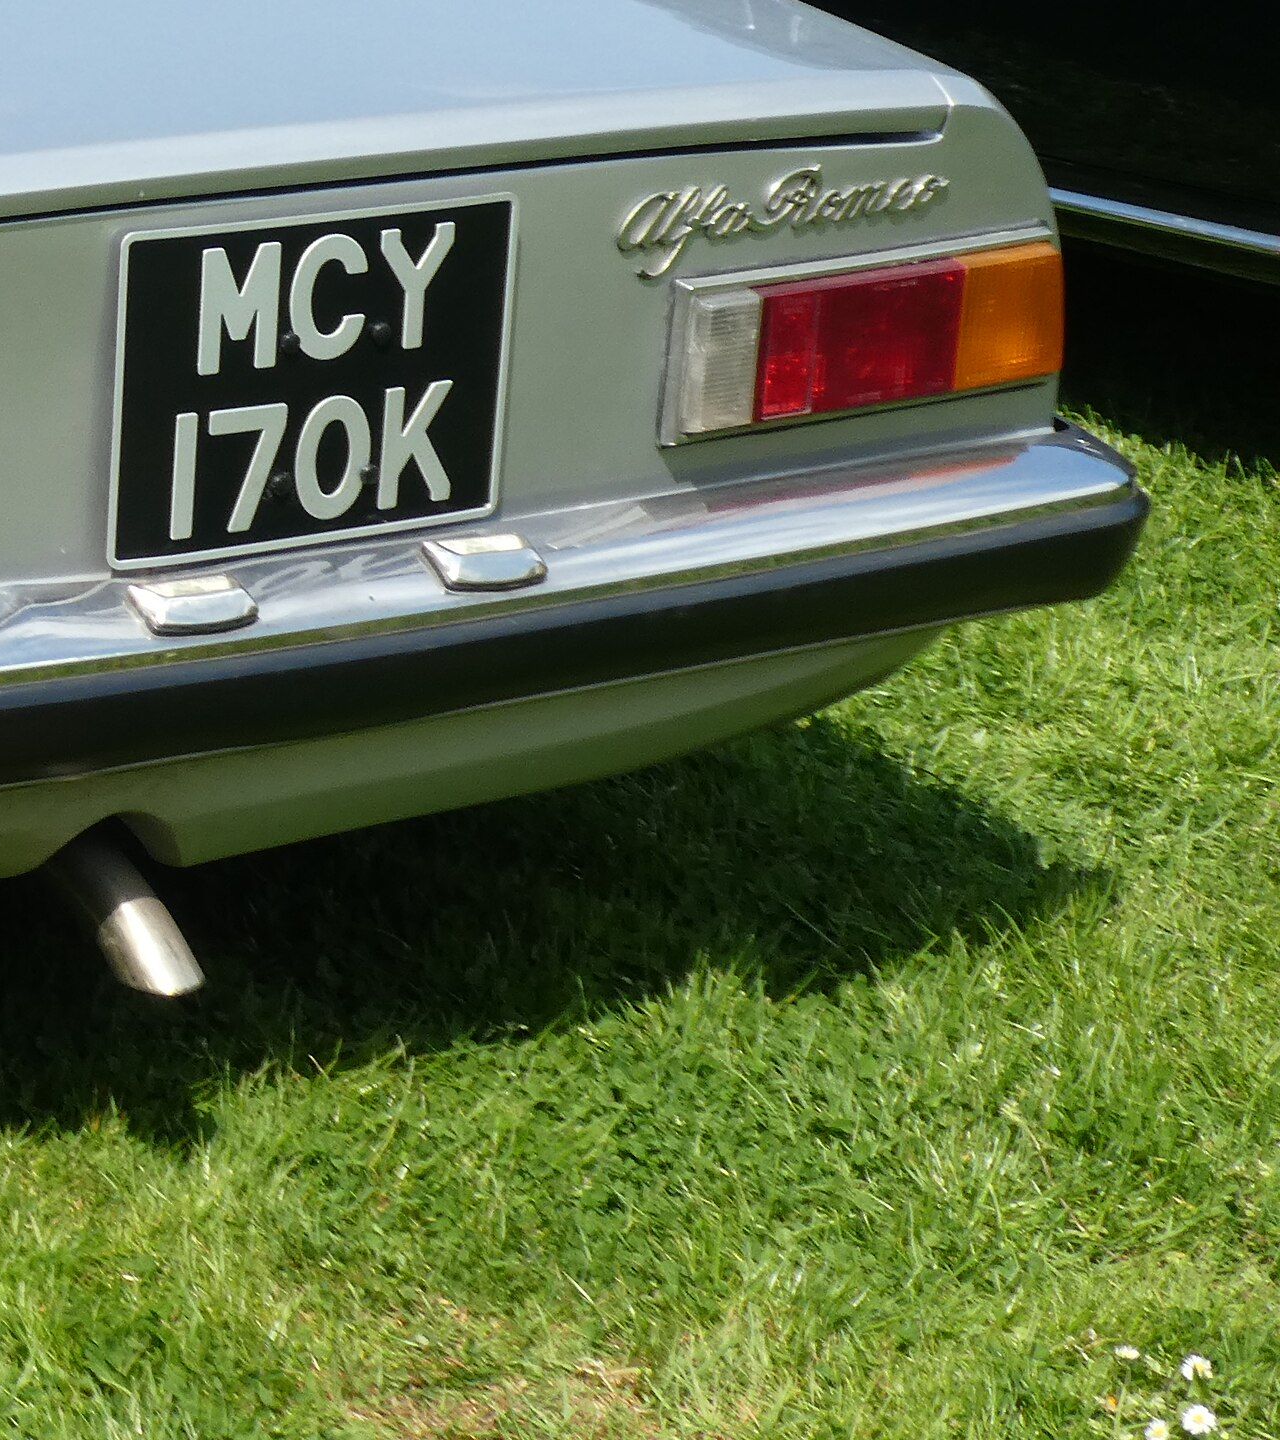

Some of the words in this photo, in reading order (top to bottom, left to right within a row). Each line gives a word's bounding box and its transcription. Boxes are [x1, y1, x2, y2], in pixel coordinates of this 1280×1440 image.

[197, 221, 457, 377] MCY
[614, 182, 752, 280] Alfa
[754, 163, 952, 229] Romeo
[169, 378, 455, 541] 170K
